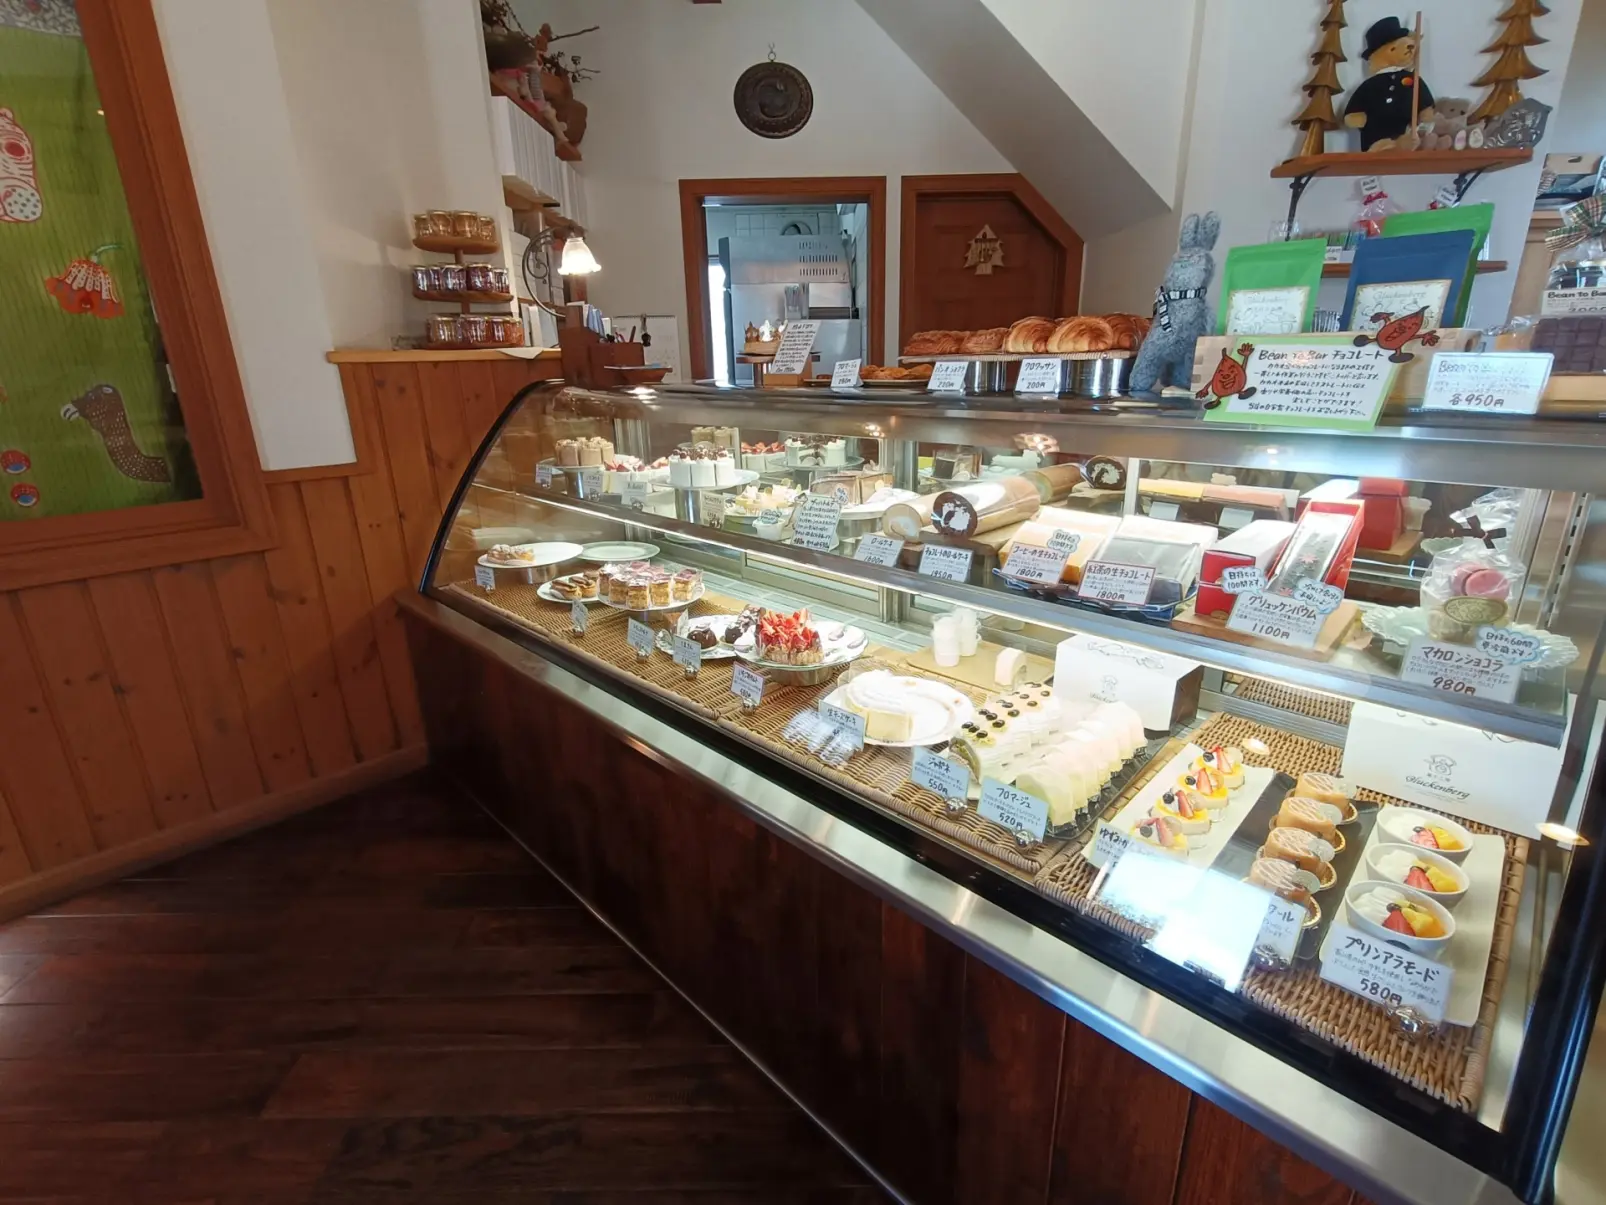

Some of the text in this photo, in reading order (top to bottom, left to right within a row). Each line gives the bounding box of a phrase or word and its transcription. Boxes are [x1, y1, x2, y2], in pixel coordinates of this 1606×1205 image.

[1258, 350, 1288, 361] Bean
[1308, 350, 1329, 360] Bar
[1332, 350, 1384, 361] チョコレート
[1025, 361, 1057, 371] クロワッサン
[1026, 381, 1046, 390] 200円
[1016, 568, 1043, 579] 1800円
[1087, 564, 1151, 581] 紅茶の生チョコレート
[1096, 590, 1126, 601] 1800円
[1248, 595, 1317, 621] グリュッケンバウム
[1251, 622, 1291, 640] 1100円
[1421, 646, 1504, 672] マカロンショコラ
[1433, 676, 1477, 696] 980円
[928, 778, 949, 795] 550円
[996, 787, 1032, 809] フロマージュ
[998, 812, 1023, 830] 520円
[1344, 935, 1441, 983] プリンアラモード
[1360, 977, 1403, 1006] 580円
